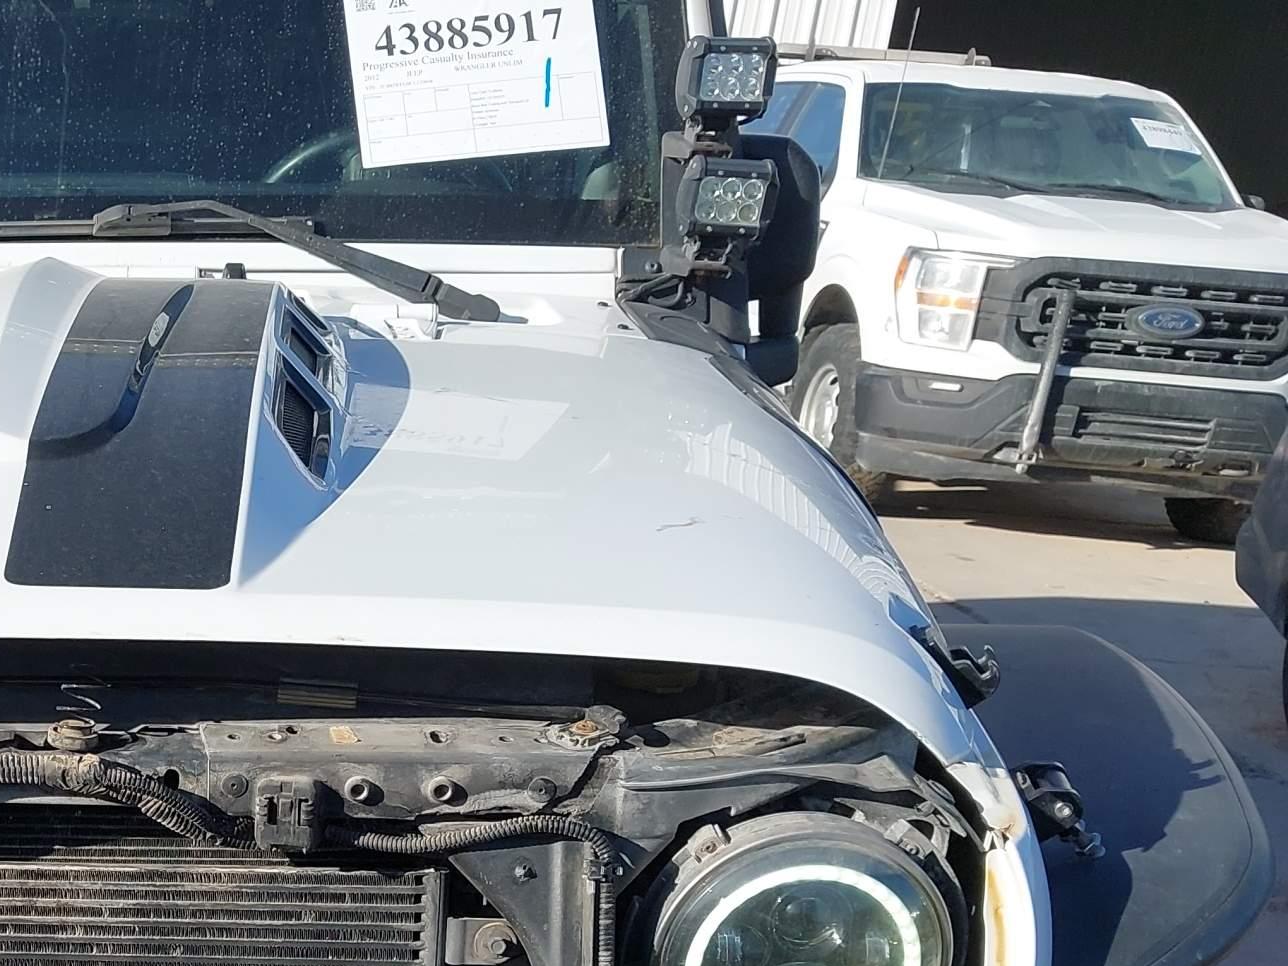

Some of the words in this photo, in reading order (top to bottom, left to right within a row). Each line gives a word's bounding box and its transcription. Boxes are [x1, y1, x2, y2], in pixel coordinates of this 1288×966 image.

[375, 7, 562, 56] 43885917
[362, 59, 419, 75] Progressive
[421, 53, 464, 66] Casualty
[467, 49, 514, 61] Insurance
[1153, 313, 1189, 330] Ford
